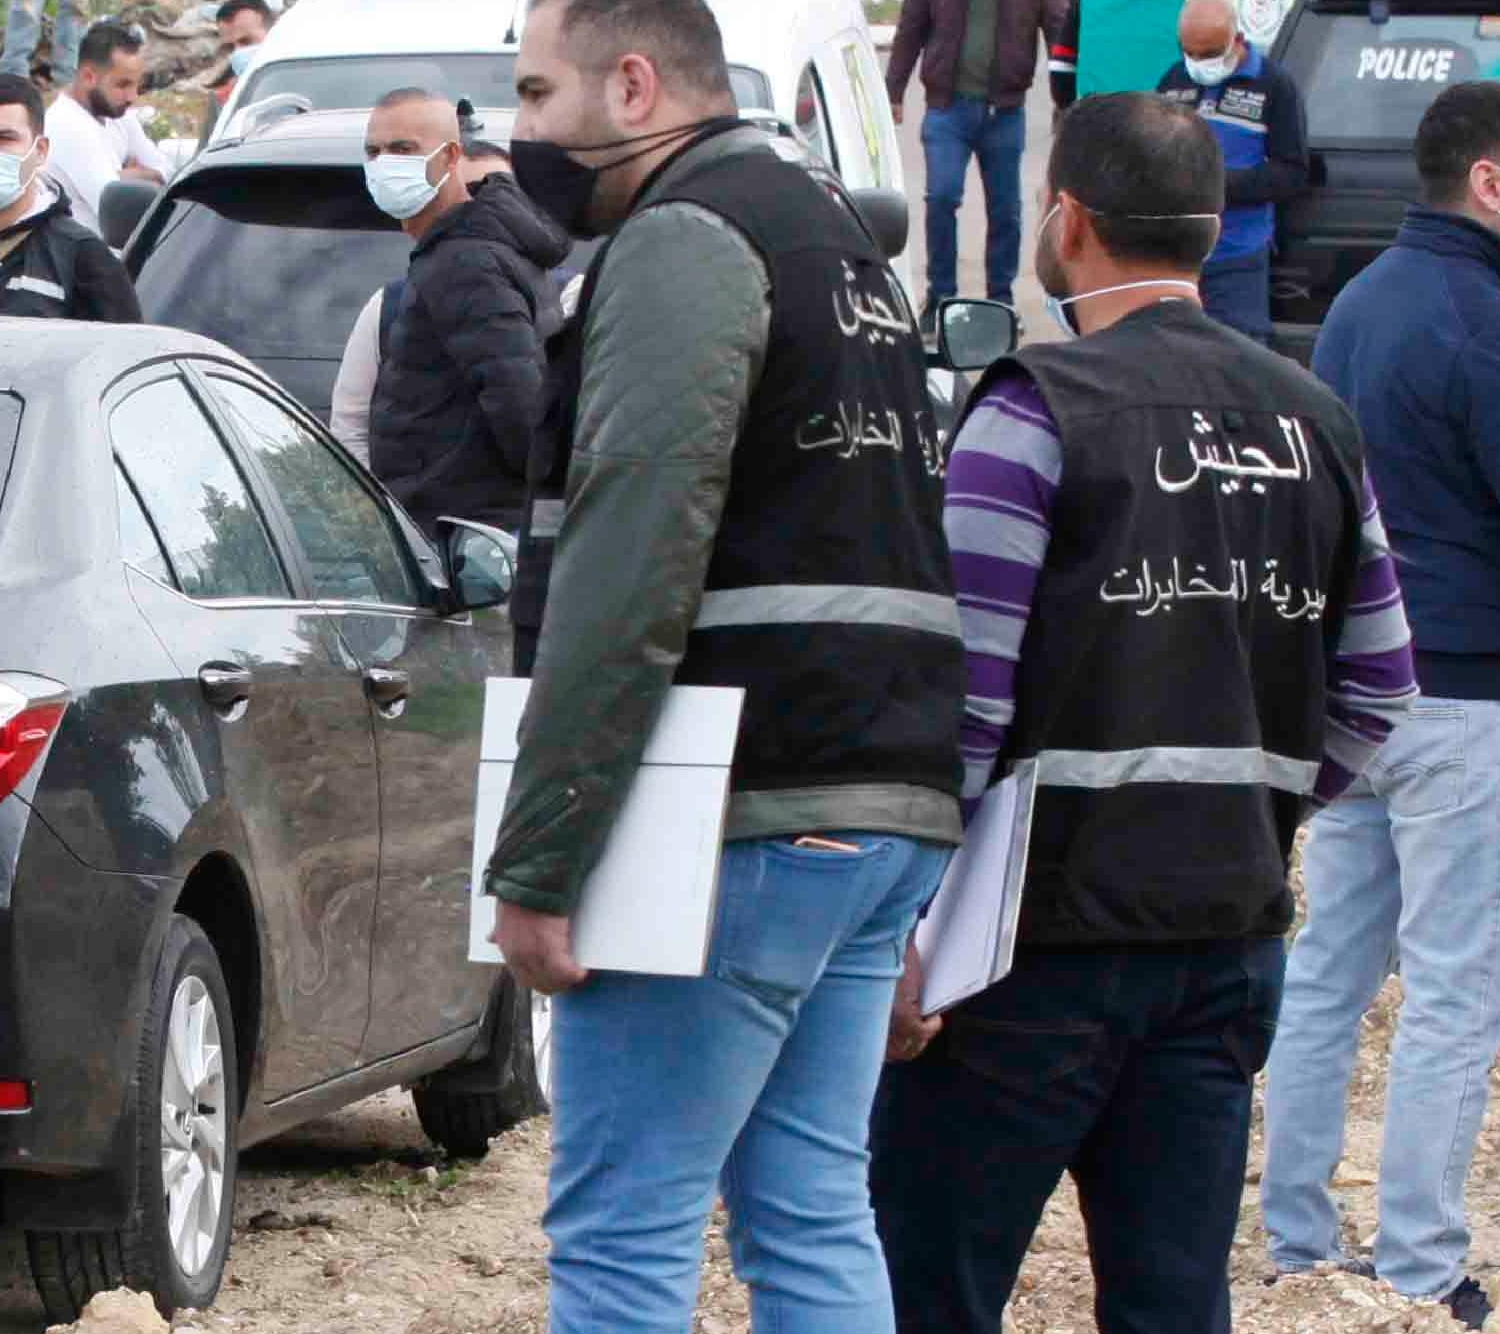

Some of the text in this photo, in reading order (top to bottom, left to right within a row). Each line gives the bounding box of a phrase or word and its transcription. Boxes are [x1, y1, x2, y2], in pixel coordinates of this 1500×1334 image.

[1355, 46, 1455, 83] POLICE
[1154, 410, 1312, 495] الجيش
[1099, 557, 1328, 623] يرية المخابرات
